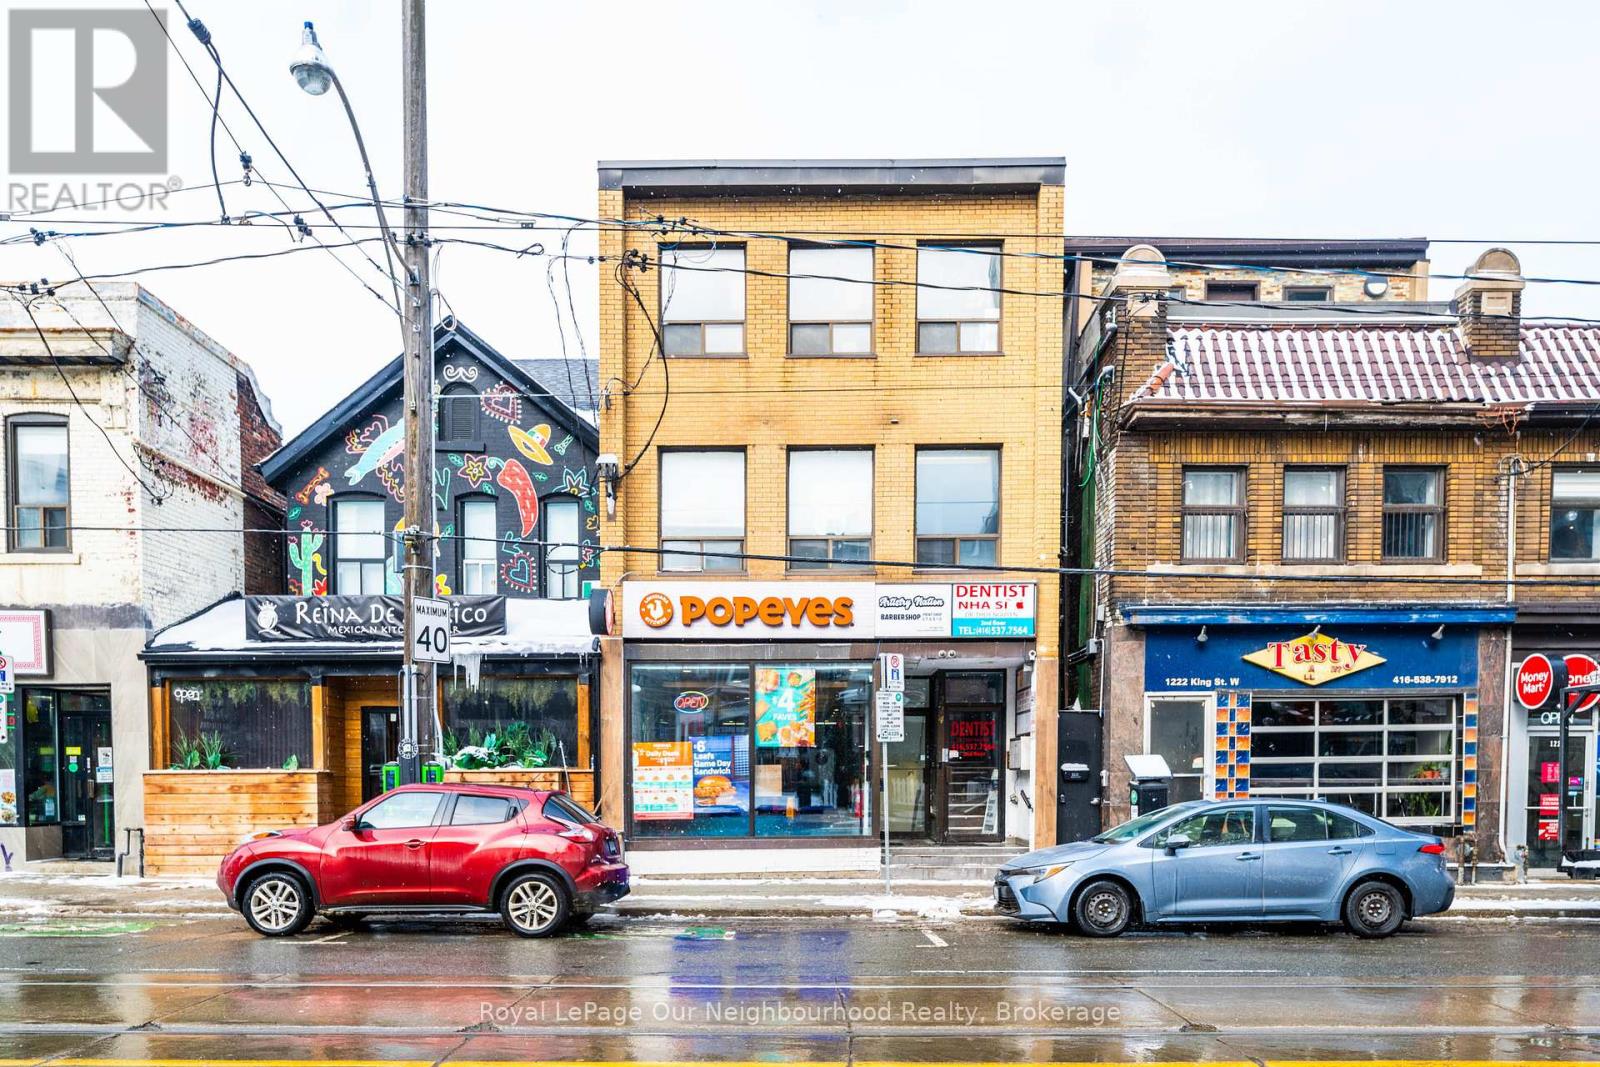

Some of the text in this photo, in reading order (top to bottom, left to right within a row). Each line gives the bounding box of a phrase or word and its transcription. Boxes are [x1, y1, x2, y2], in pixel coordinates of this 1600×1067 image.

[956, 585, 1029, 598] DENTIST
[416, 604, 448, 618] MAXIMUM
[679, 596, 854, 627] POPEYES
[958, 601, 1007, 610] NHA SI
[880, 613, 921, 621] BARBERSHOP
[327, 625, 377, 634] MEXICAN
[416, 625, 448, 654] 40
[1267, 637, 1367, 671] Tasty
[1165, 677, 1240, 688] 1222 King St. W
[1520, 672, 1549, 685] Money
[174, 686, 203, 704] open
[1522, 682, 1543, 695] Mart
[676, 695, 706, 709] OPEN
[950, 719, 996, 737] DENTIST
[693, 767, 732, 776] Sandwich
